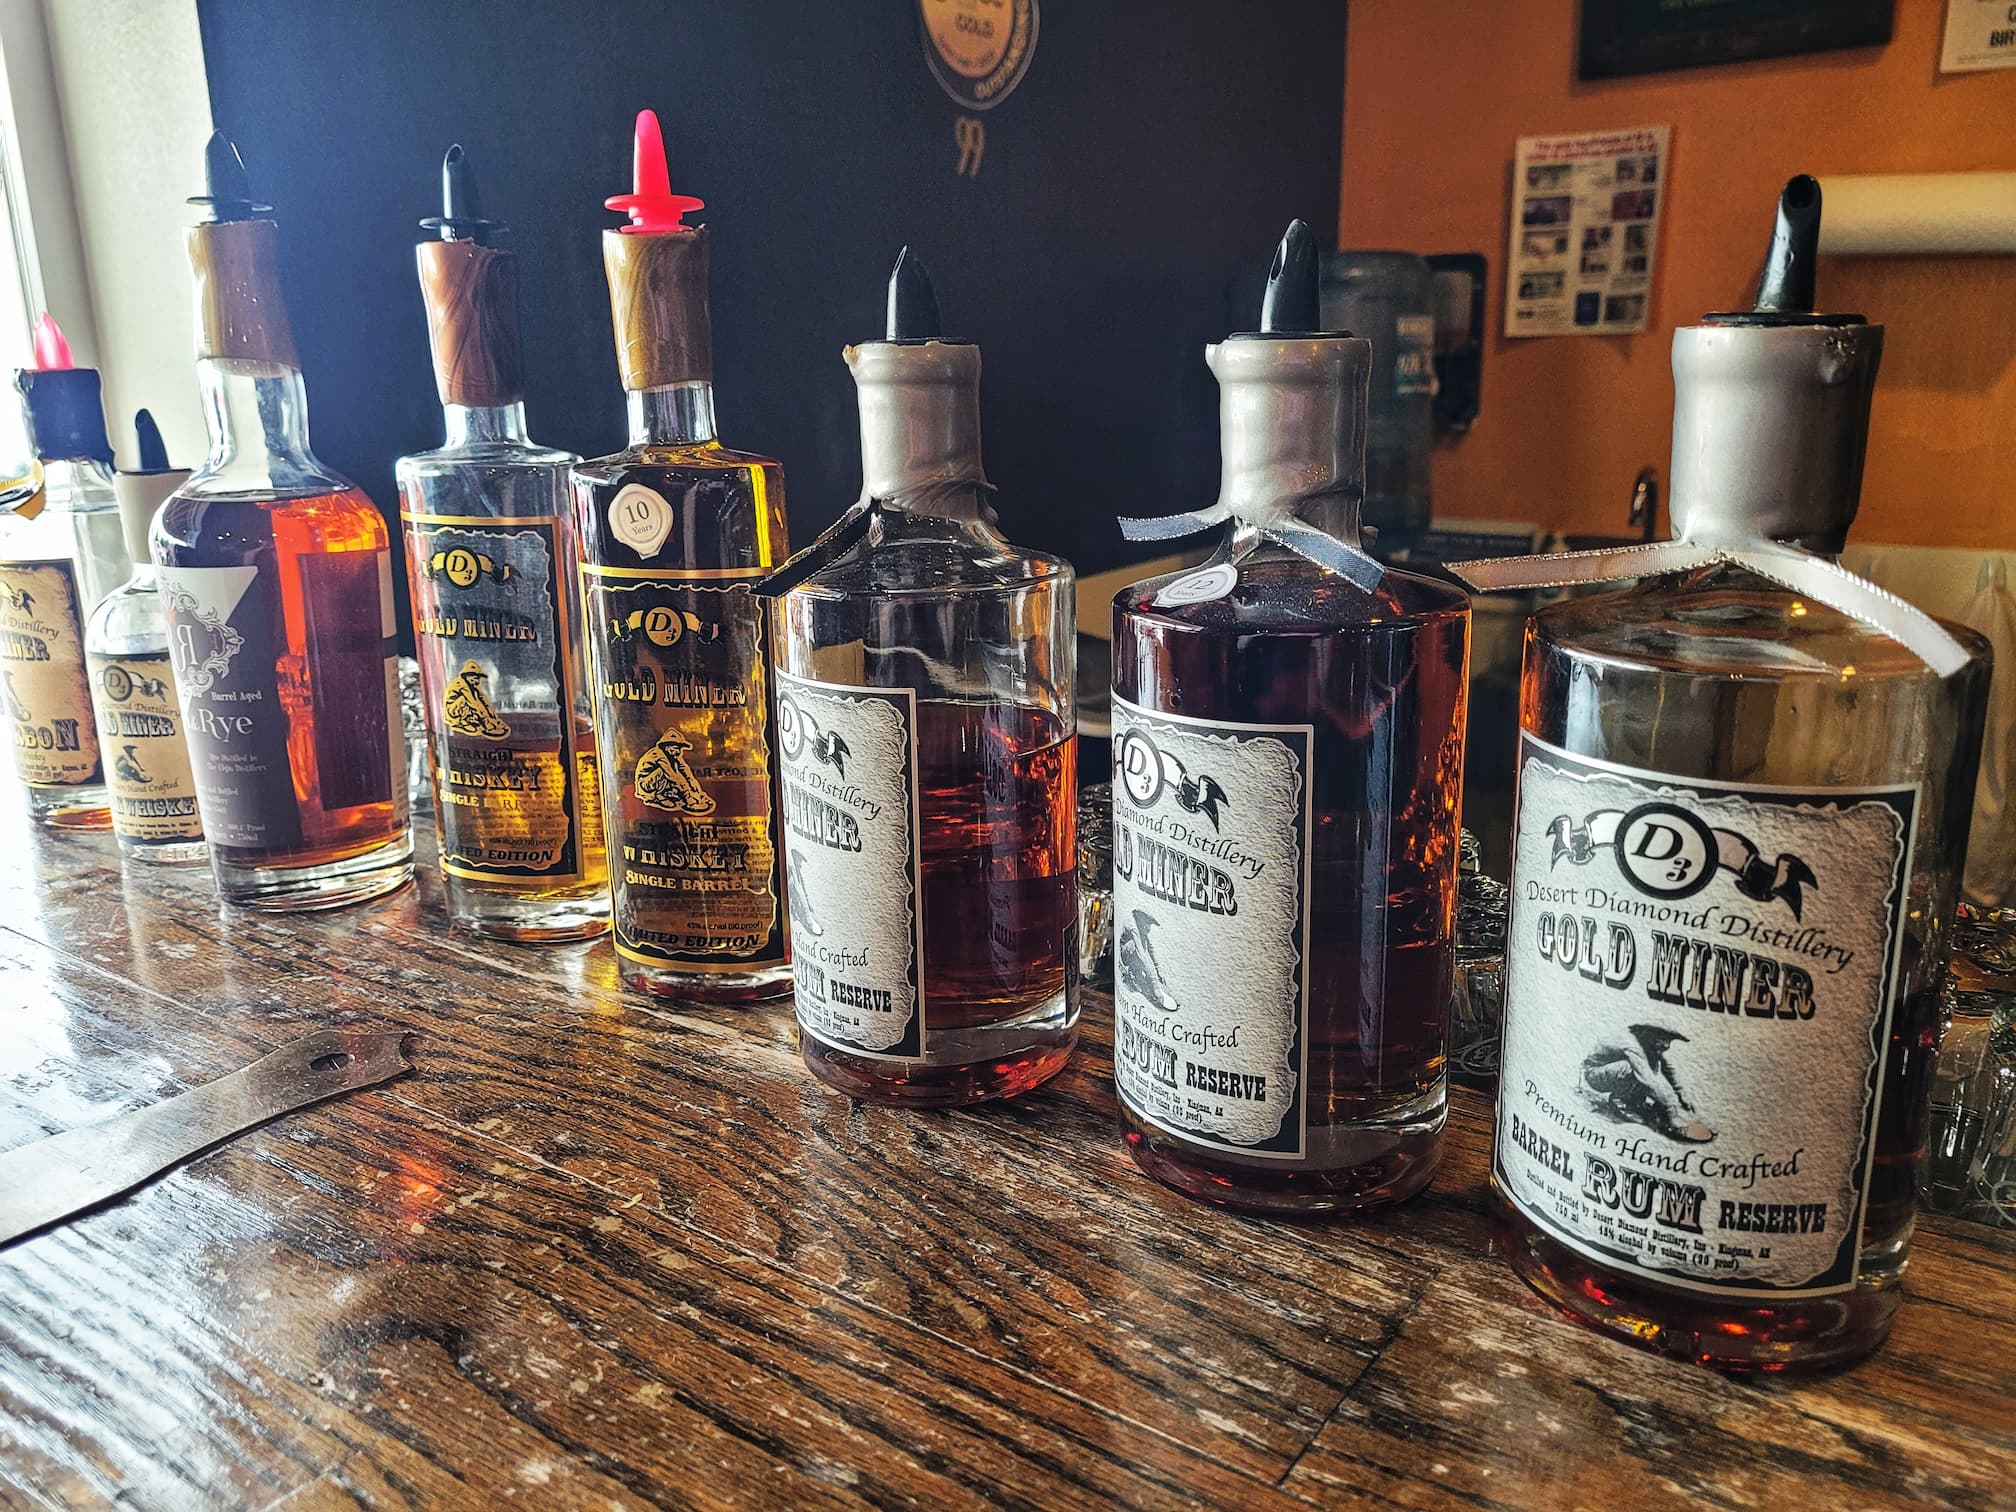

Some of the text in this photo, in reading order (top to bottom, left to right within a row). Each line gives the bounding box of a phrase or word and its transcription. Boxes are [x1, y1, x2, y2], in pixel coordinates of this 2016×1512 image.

[624, 501, 650, 525] 10
[631, 524, 654, 536] Years
[1184, 580, 1214, 590] 12
[9, 615, 60, 640] Distillery
[648, 612, 677, 641] D3
[134, 702, 181, 721] Distillery
[210, 690, 263, 703] Barrel Aged
[119, 712, 176, 738] MINER
[197, 708, 254, 742] Rye
[1126, 744, 1153, 794] D3
[439, 789, 480, 807] SINGLE
[810, 772, 882, 821] Distillery
[789, 781, 862, 853] MINER
[488, 850, 554, 864] EDITION
[1169, 823, 1266, 880] Distillery
[1630, 822, 1690, 882] D3
[625, 869, 766, 895] SINGLE BARREL
[1136, 831, 1238, 916] MINER
[685, 933, 760, 948] EDITION
[1526, 880, 1854, 974] Desert Diamond Distillery
[820, 947, 869, 973] Crafted
[1537, 911, 1816, 1020] GOLD MINER
[830, 978, 892, 1013] RESERVE
[1132, 1003, 1170, 1037] Hand
[1171, 1025, 1241, 1055] Crafted
[1121, 1015, 1178, 1090] RUM
[1185, 1061, 1266, 1103] RESERVE
[1524, 1079, 1804, 1190] Premium Hand Crafted
[1511, 1112, 1828, 1236] BARREL RUM RESERVE
[1582, 1202, 1590, 1217] by
[1592, 1211, 1613, 1226] Desert
[1617, 1218, 1649, 1237] Diamond
[1618, 1233, 1643, 1250] alcohol
[1647, 1242, 1656, 1255] by
[1660, 1247, 1687, 1261] volume
[1714, 1258, 1740, 1270] proof)
